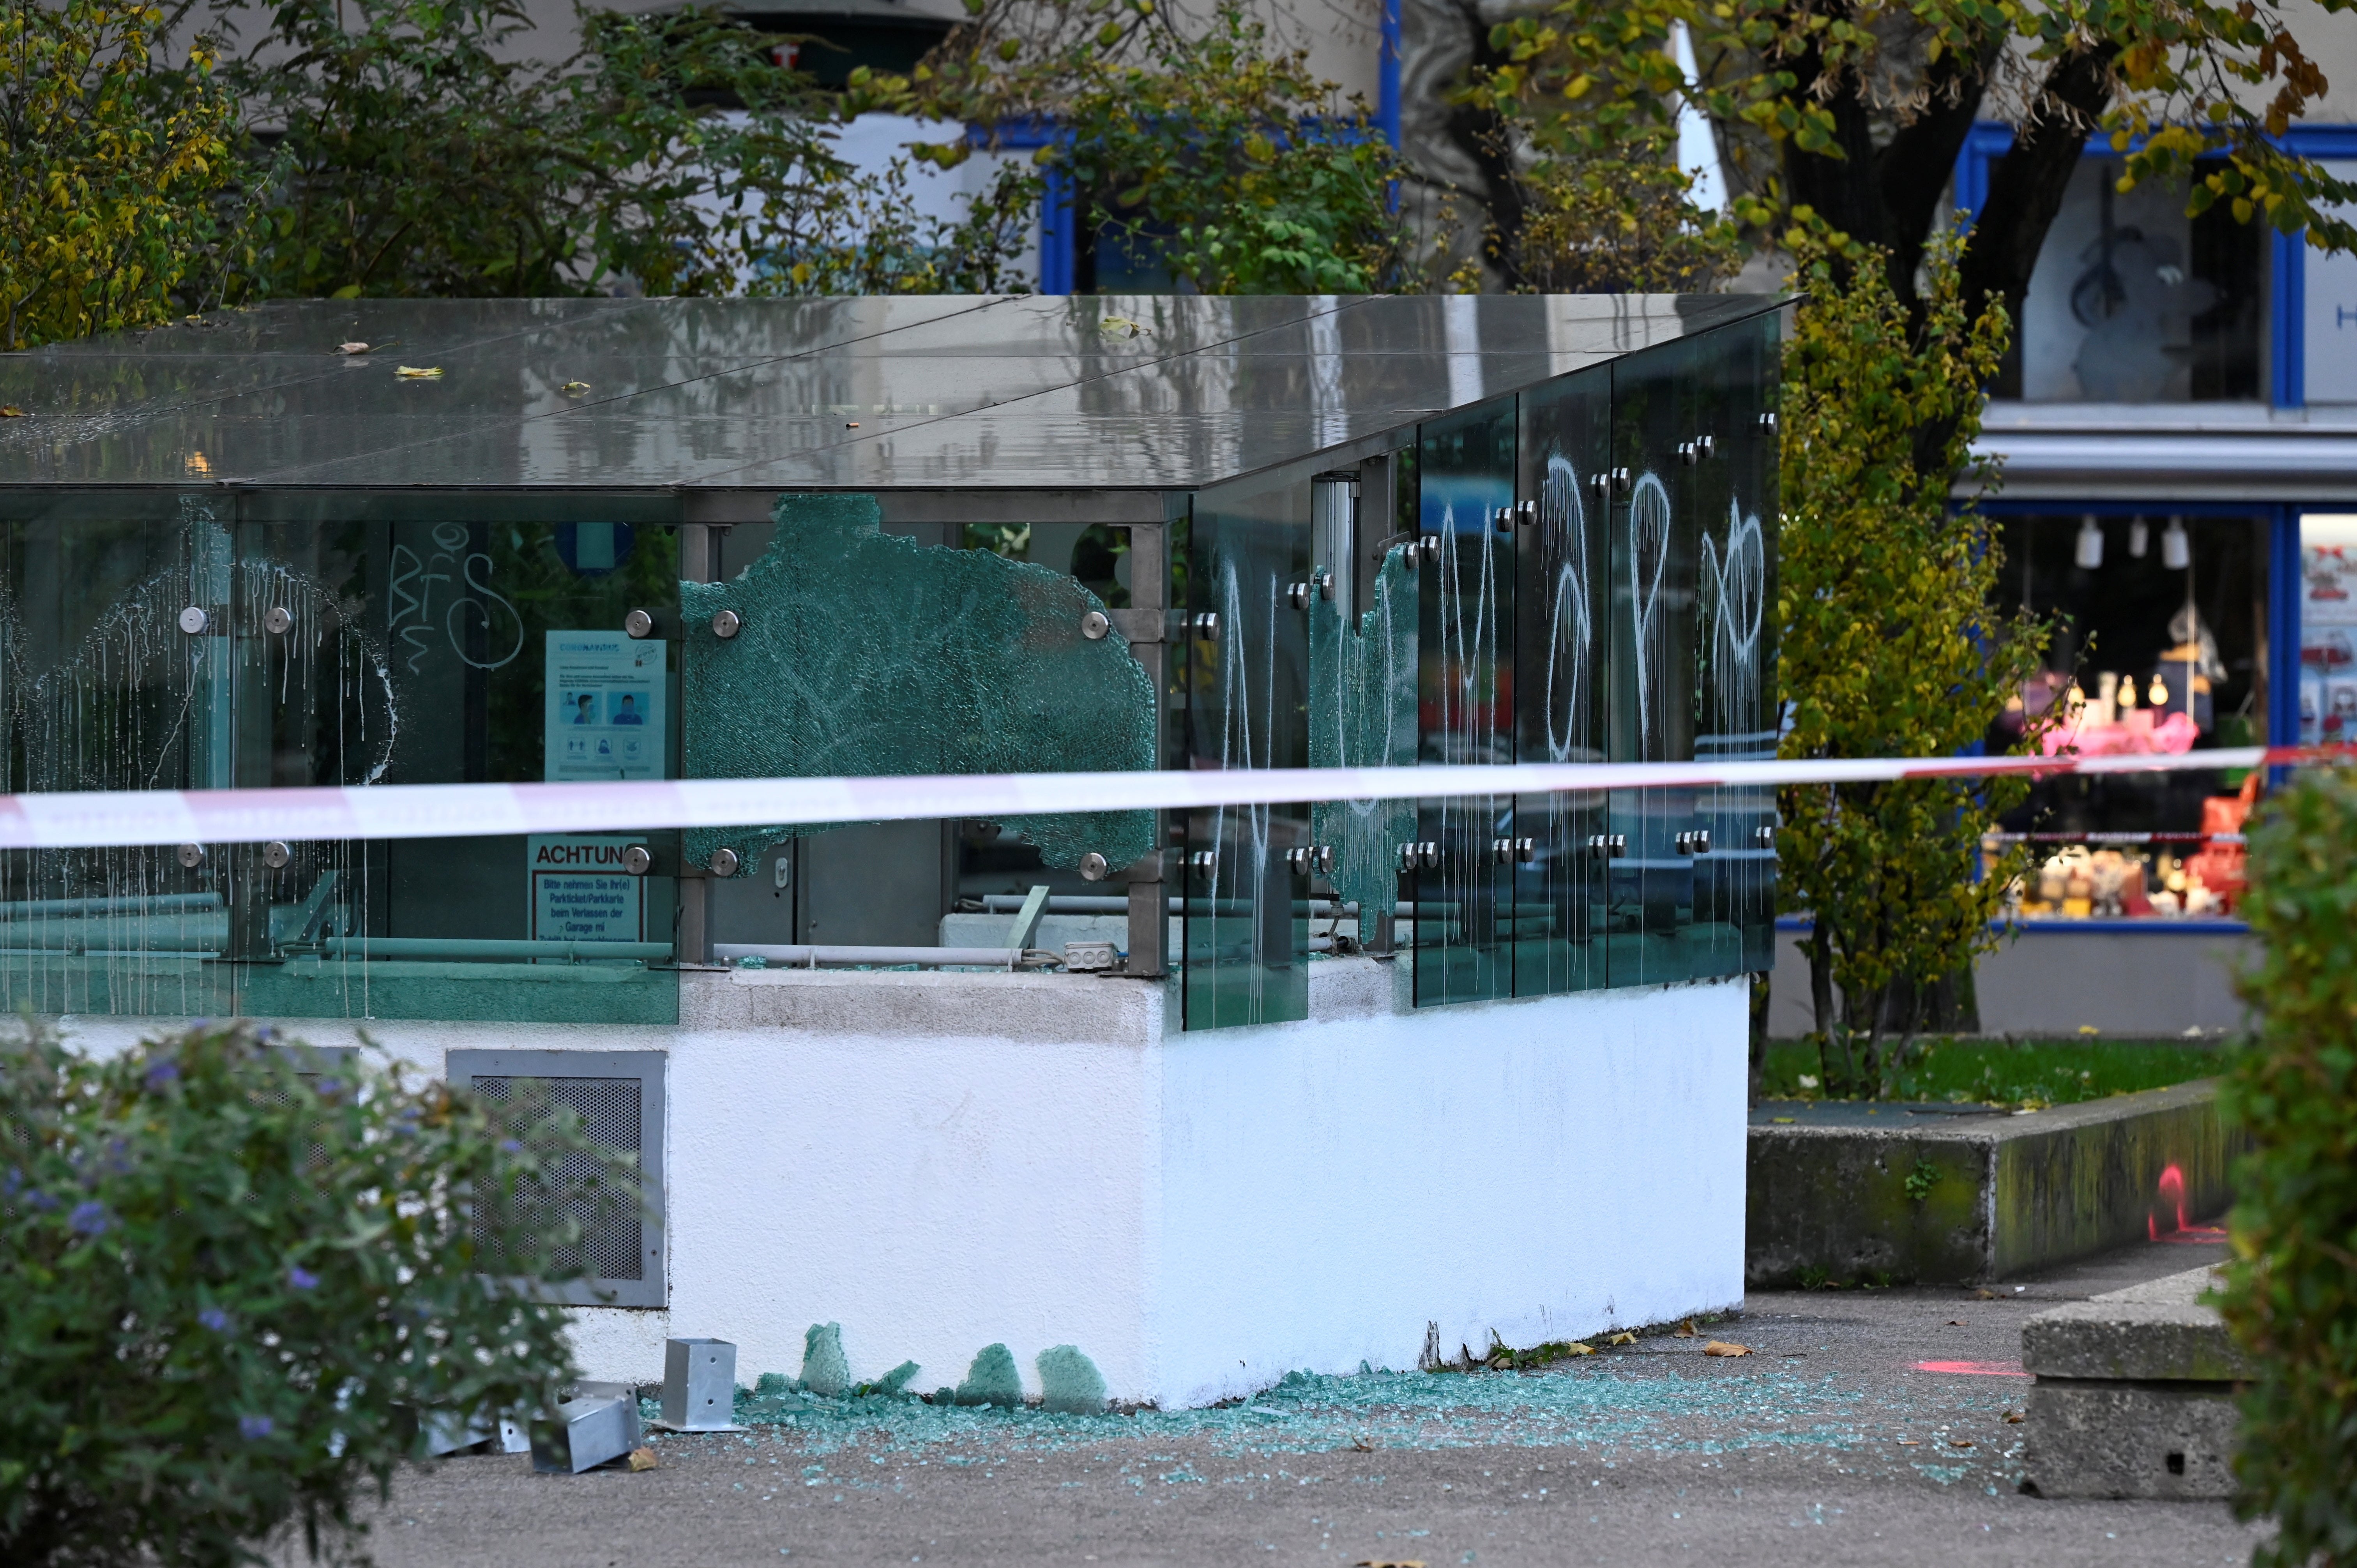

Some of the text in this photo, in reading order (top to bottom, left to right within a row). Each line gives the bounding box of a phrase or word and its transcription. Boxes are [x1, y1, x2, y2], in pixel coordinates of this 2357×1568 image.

[537, 845, 623, 863] ACHTUN
[544, 879, 560, 889] Bitte
[564, 879, 593, 889] nehmen
[596, 879, 607, 890] Sie
[551, 908, 622, 918] beim Verlassen der
[565, 921, 593, 934] Garage
